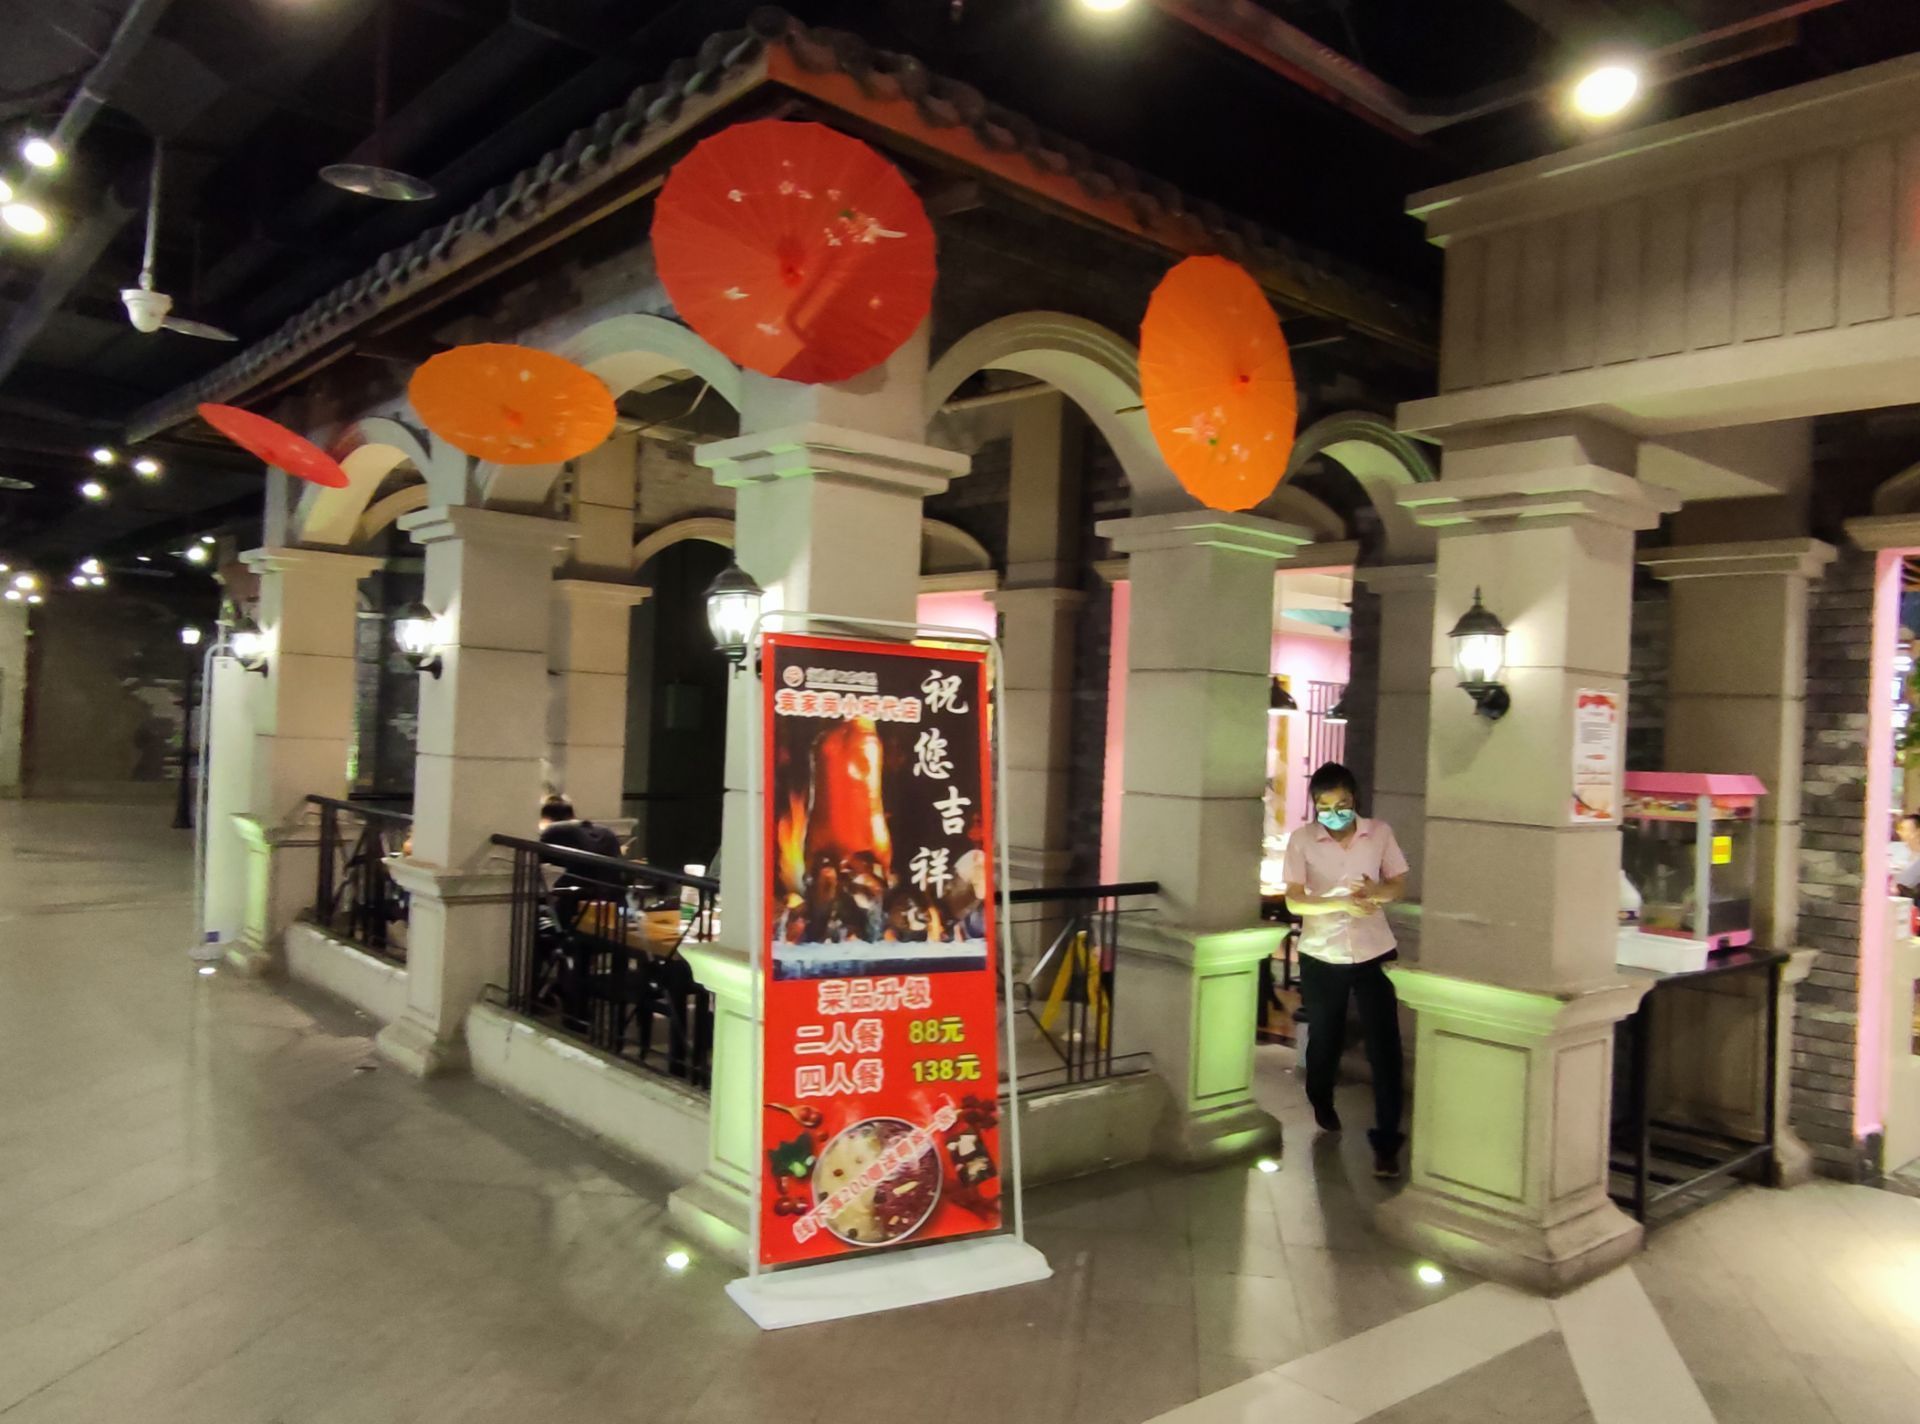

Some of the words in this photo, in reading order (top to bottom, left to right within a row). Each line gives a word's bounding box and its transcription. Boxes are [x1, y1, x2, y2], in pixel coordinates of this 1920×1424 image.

[909, 669, 972, 899] 祝您吉祥
[817, 976, 932, 1014] 菜品升级
[794, 1018, 883, 1055] 二人餐
[909, 1016, 965, 1044] 88元
[794, 1058, 883, 1098] 四人餐
[912, 1053, 981, 1083] 138元
